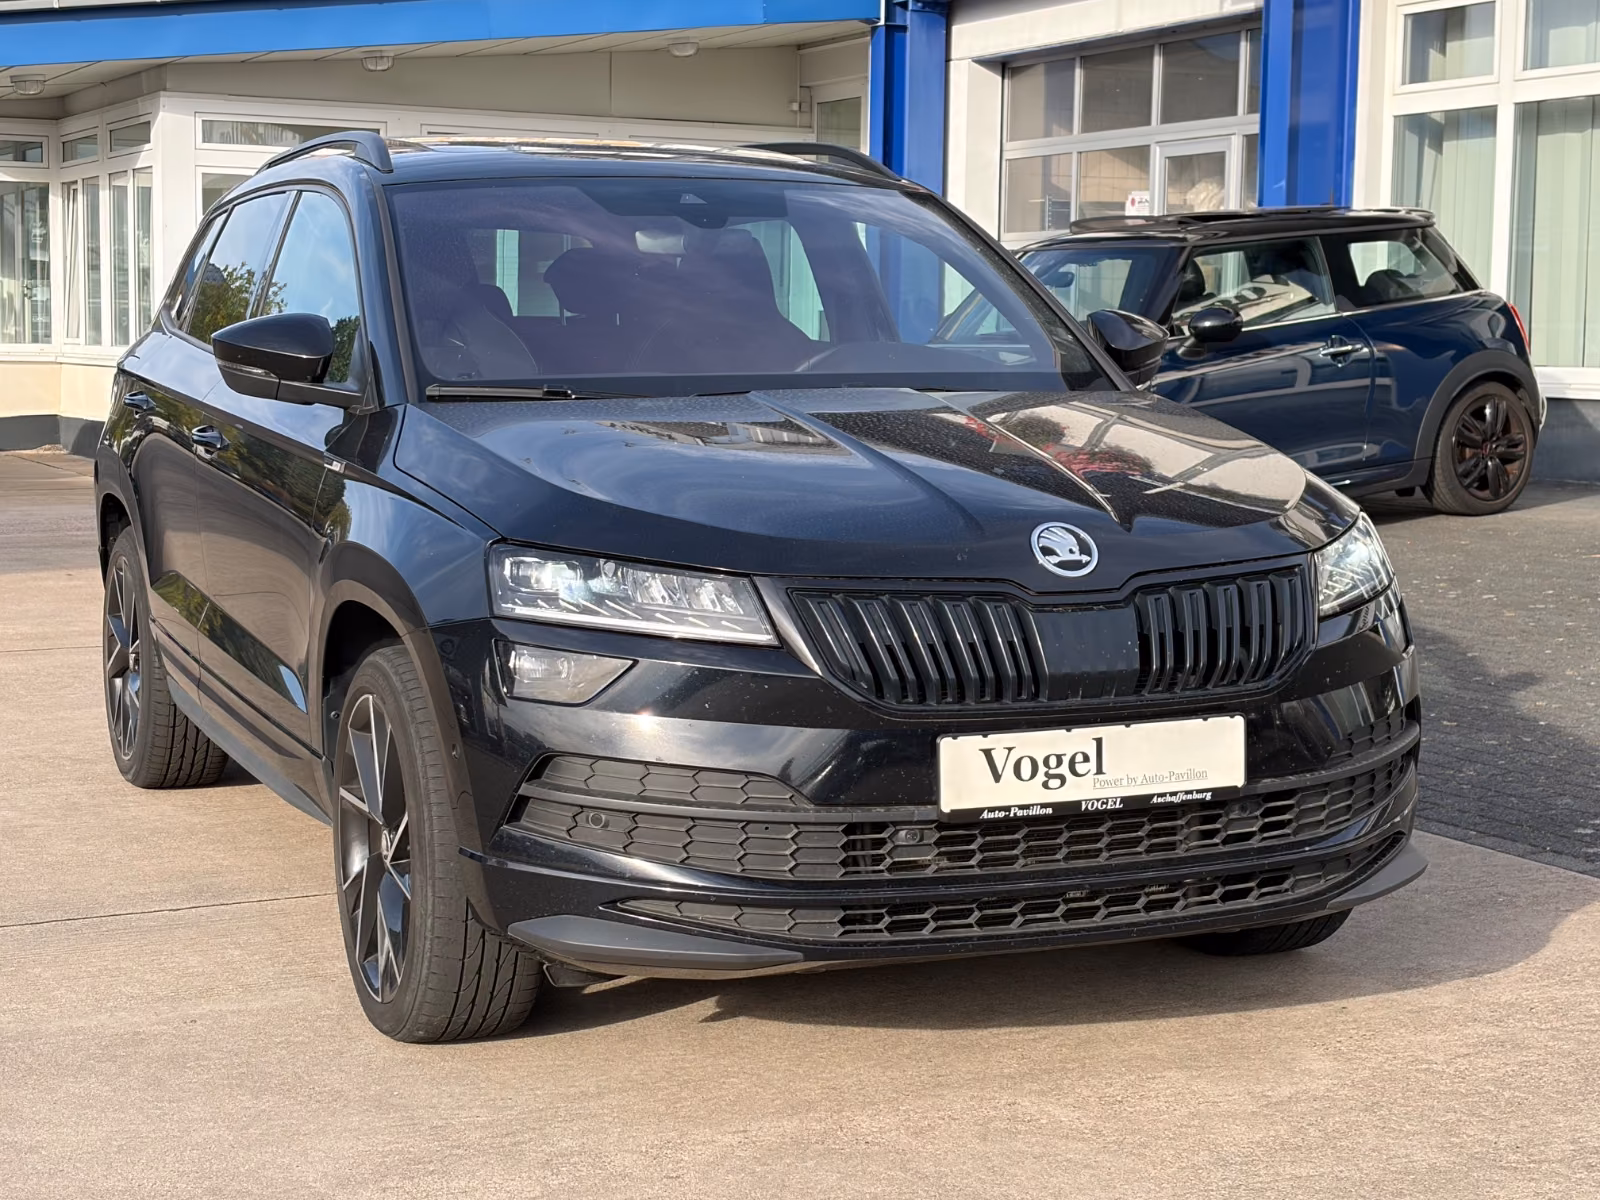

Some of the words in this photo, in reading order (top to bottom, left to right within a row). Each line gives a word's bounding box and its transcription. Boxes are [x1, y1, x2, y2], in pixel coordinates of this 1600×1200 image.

[978, 736, 1107, 790] Vogel
[1092, 777, 1125, 788] Power
[1127, 774, 1139, 787] by
[1141, 768, 1208, 784] Auto-Pavillon
[980, 805, 1053, 819] Auto-Pavillon
[1081, 798, 1124, 811] VOGEL
[1150, 790, 1212, 804] Aschaffenburg
